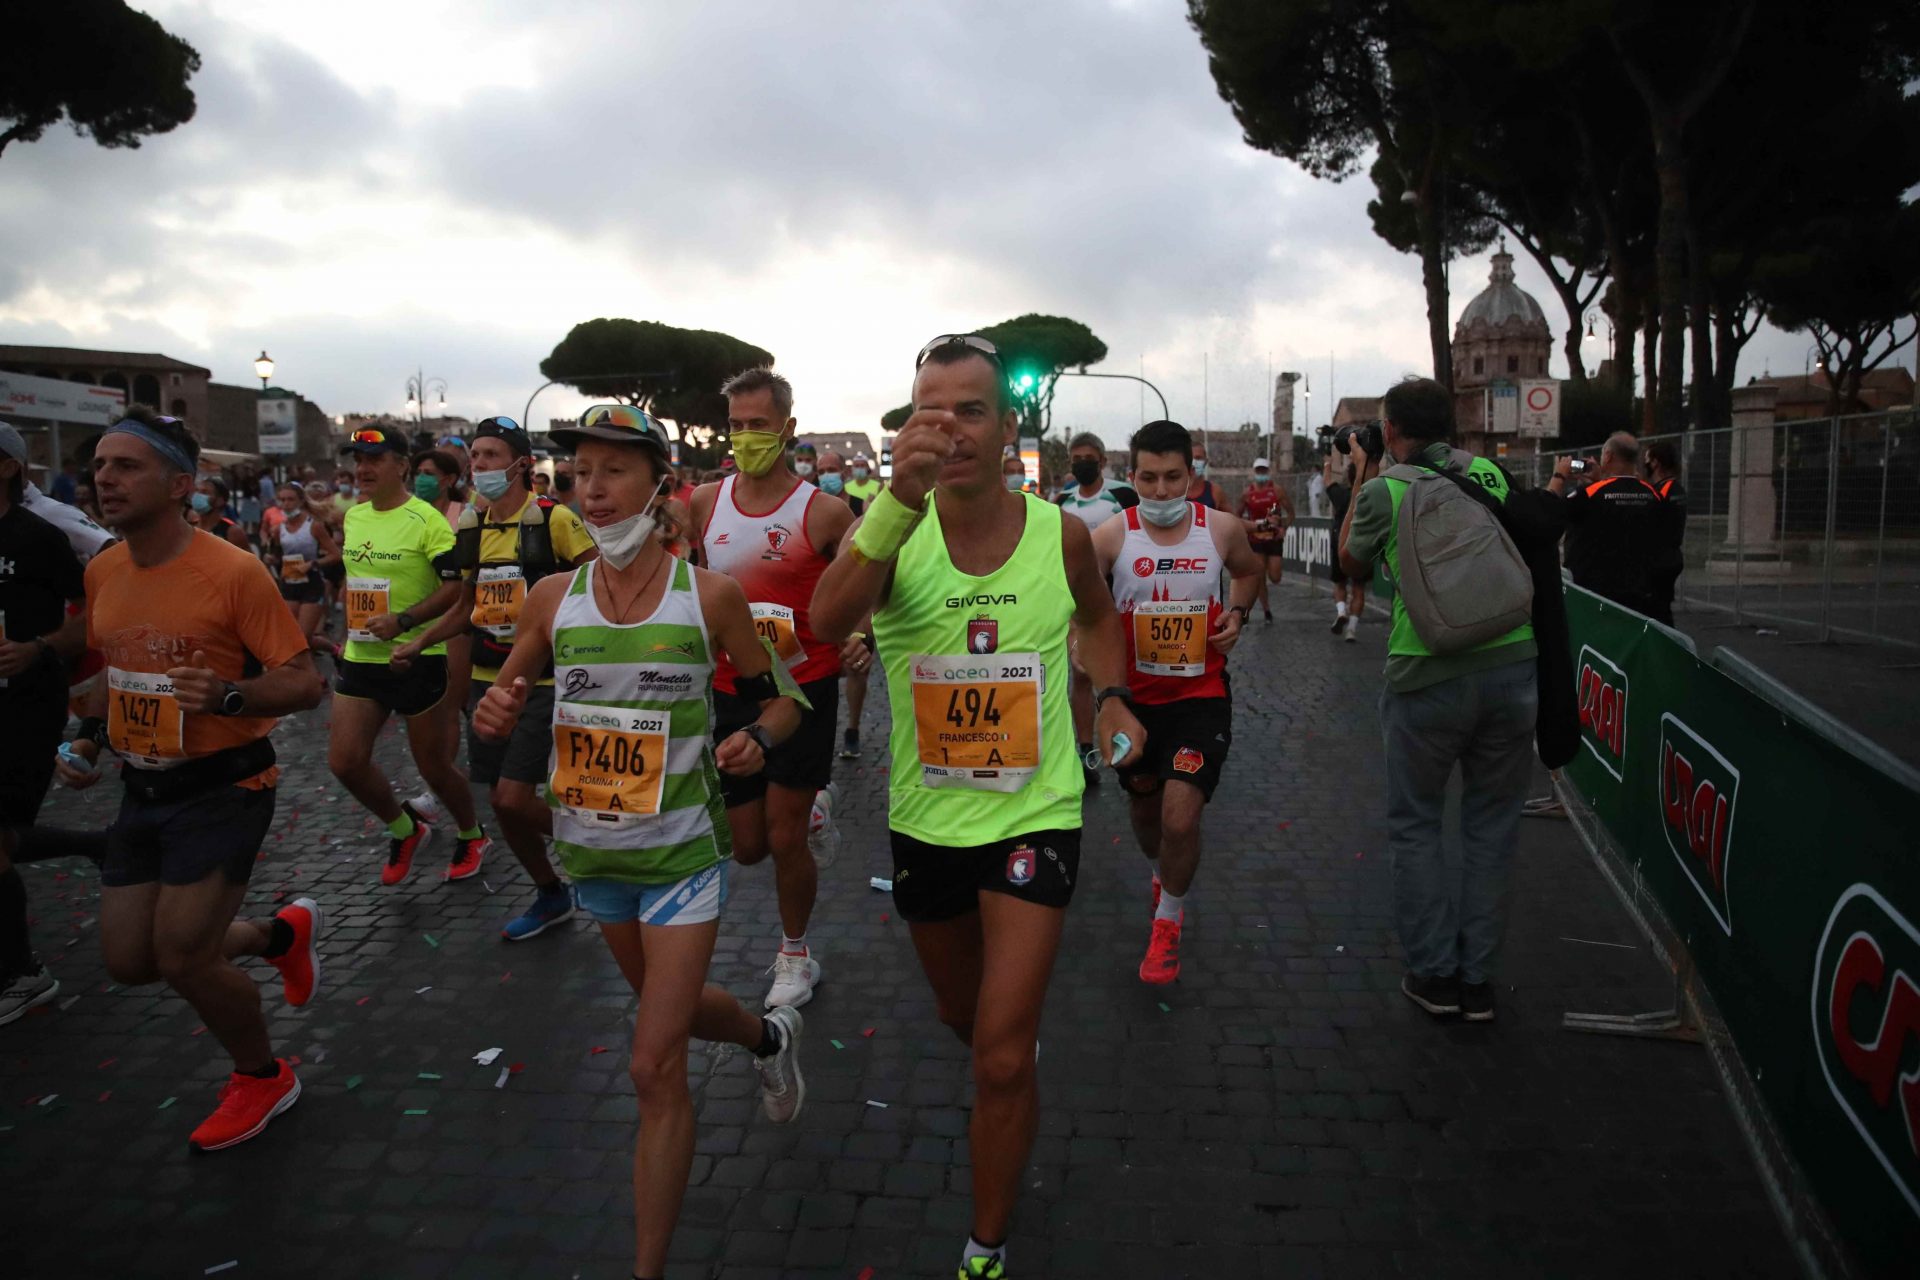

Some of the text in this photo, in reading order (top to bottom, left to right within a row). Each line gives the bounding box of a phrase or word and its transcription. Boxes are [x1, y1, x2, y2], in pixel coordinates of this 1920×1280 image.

[370, 551, 402, 561] trainer
[1299, 527, 1331, 574] upim
[1156, 558, 1208, 571] BRC
[482, 582, 513, 605] 2102
[351, 593, 376, 612] 1186
[945, 594, 1017, 609] GIVOVA
[770, 609, 790, 618] 2021
[1155, 605, 1183, 613] acea
[504, 614, 513, 624] A
[756, 620, 779, 643] 20
[1151, 617, 1193, 641] 5679
[573, 646, 606, 655] service
[1150, 651, 1189, 664] 9 A
[638, 670, 693, 684] Montello
[944, 665, 990, 680] acea
[1001, 666, 1033, 678] 2021
[121, 680, 175, 693] acea 202
[637, 684, 691, 693] RUNNERS CLUB
[119, 695, 161, 728] 1427
[946, 687, 1001, 728] 494
[580, 713, 621, 728] acea
[631, 719, 663, 731] 2021
[938, 732, 999, 744] FRANCESCO
[148, 742, 161, 756] A
[569, 731, 645, 776] F1406
[940, 746, 950, 765] 1
[986, 748, 1004, 766] A
[578, 774, 613, 788] ROMINA
[565, 787, 625, 811] F3 A
